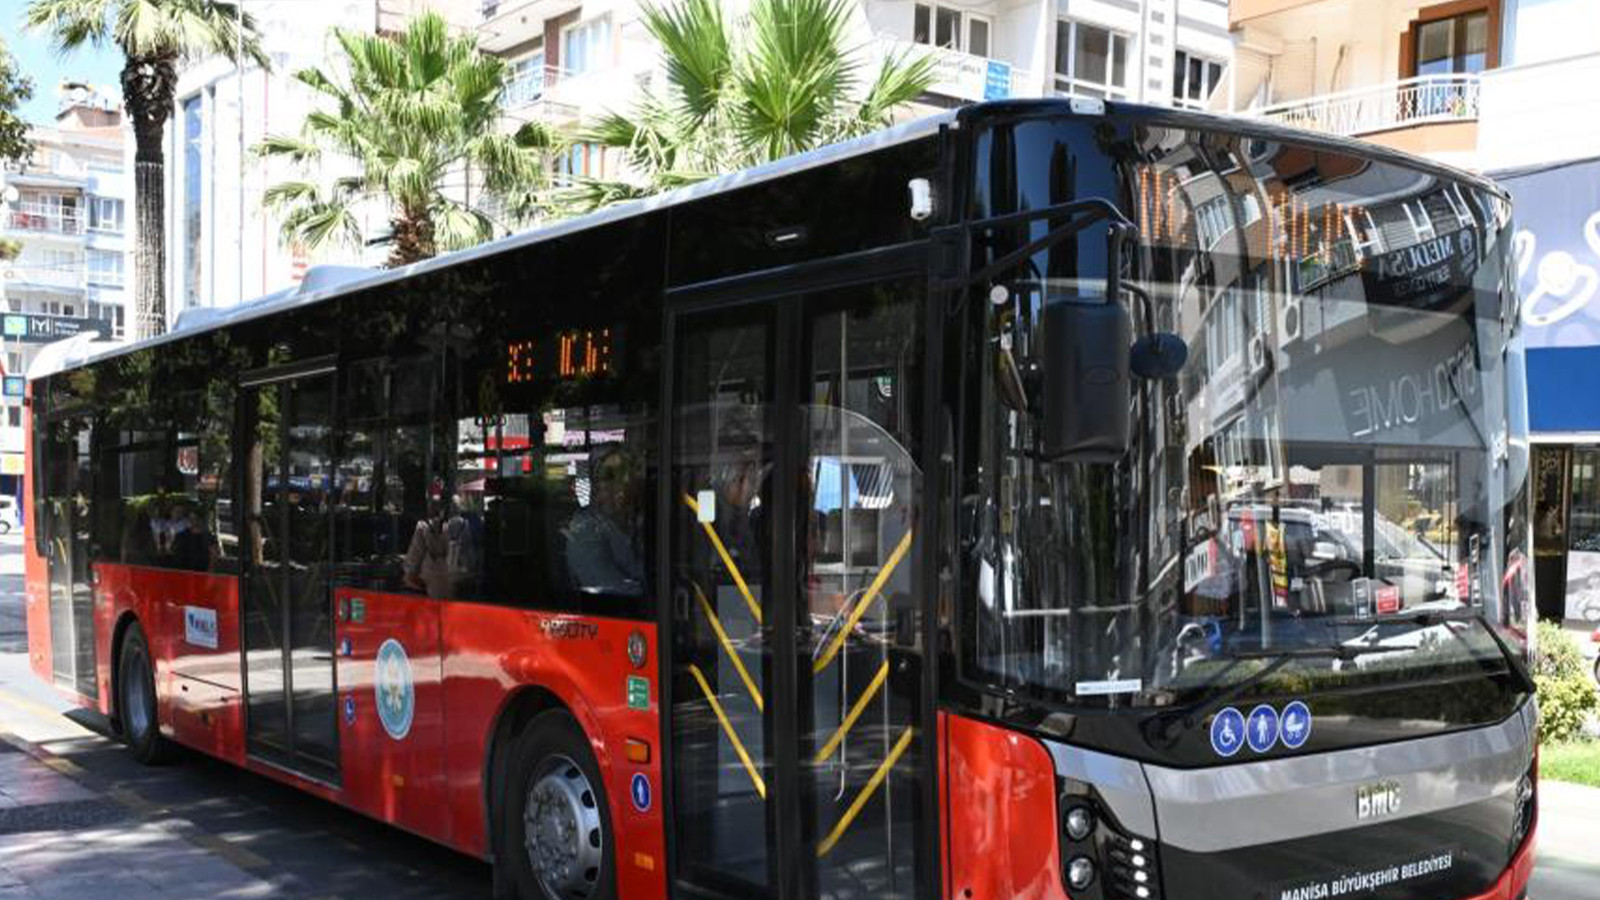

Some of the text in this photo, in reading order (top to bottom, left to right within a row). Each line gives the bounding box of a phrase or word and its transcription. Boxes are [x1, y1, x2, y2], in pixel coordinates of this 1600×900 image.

[1357, 781, 1401, 819] BMC
[1281, 851, 1451, 900] MANİSA BÜYÜKŞEHİR BELEDİYESİ
